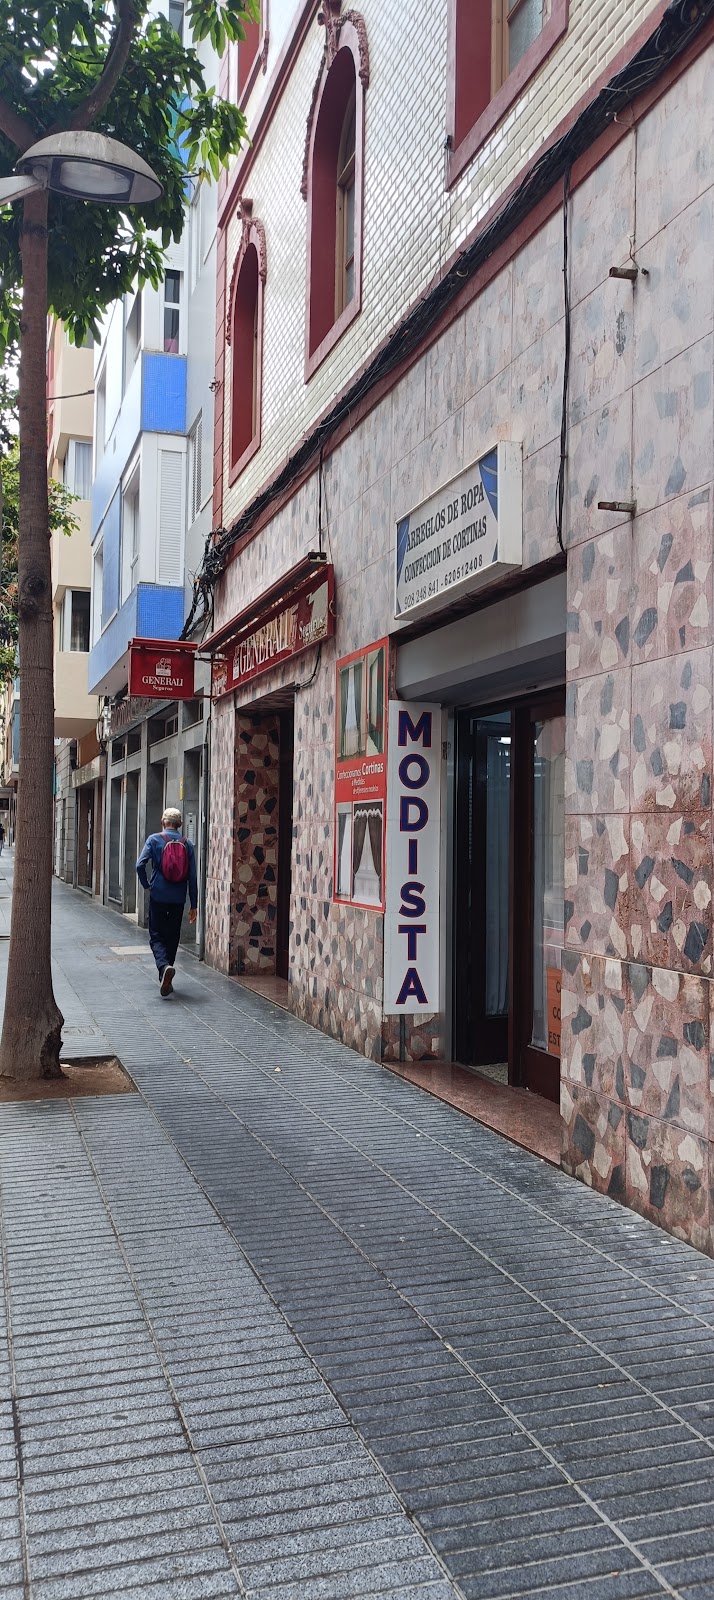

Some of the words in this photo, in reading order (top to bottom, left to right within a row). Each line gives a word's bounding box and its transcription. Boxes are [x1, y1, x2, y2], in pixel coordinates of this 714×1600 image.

[406, 508, 446, 553] ARREGLOS
[447, 498, 459, 525] DE
[460, 481, 485, 516] ROPA
[404, 544, 441, 583] CONFECCION
[442, 538, 452, 561] DE
[452, 515, 487, 555] CORTINAS
[404, 592, 415, 610] 928
[415, 586, 427, 604] 248
[427, 579, 439, 598] 841
[444, 554, 483, 586] 620512408
[142, 675, 184, 687] GENERALI
[361, 761, 384, 775] Cortinas
[396, 710, 432, 1005] MODISTA
